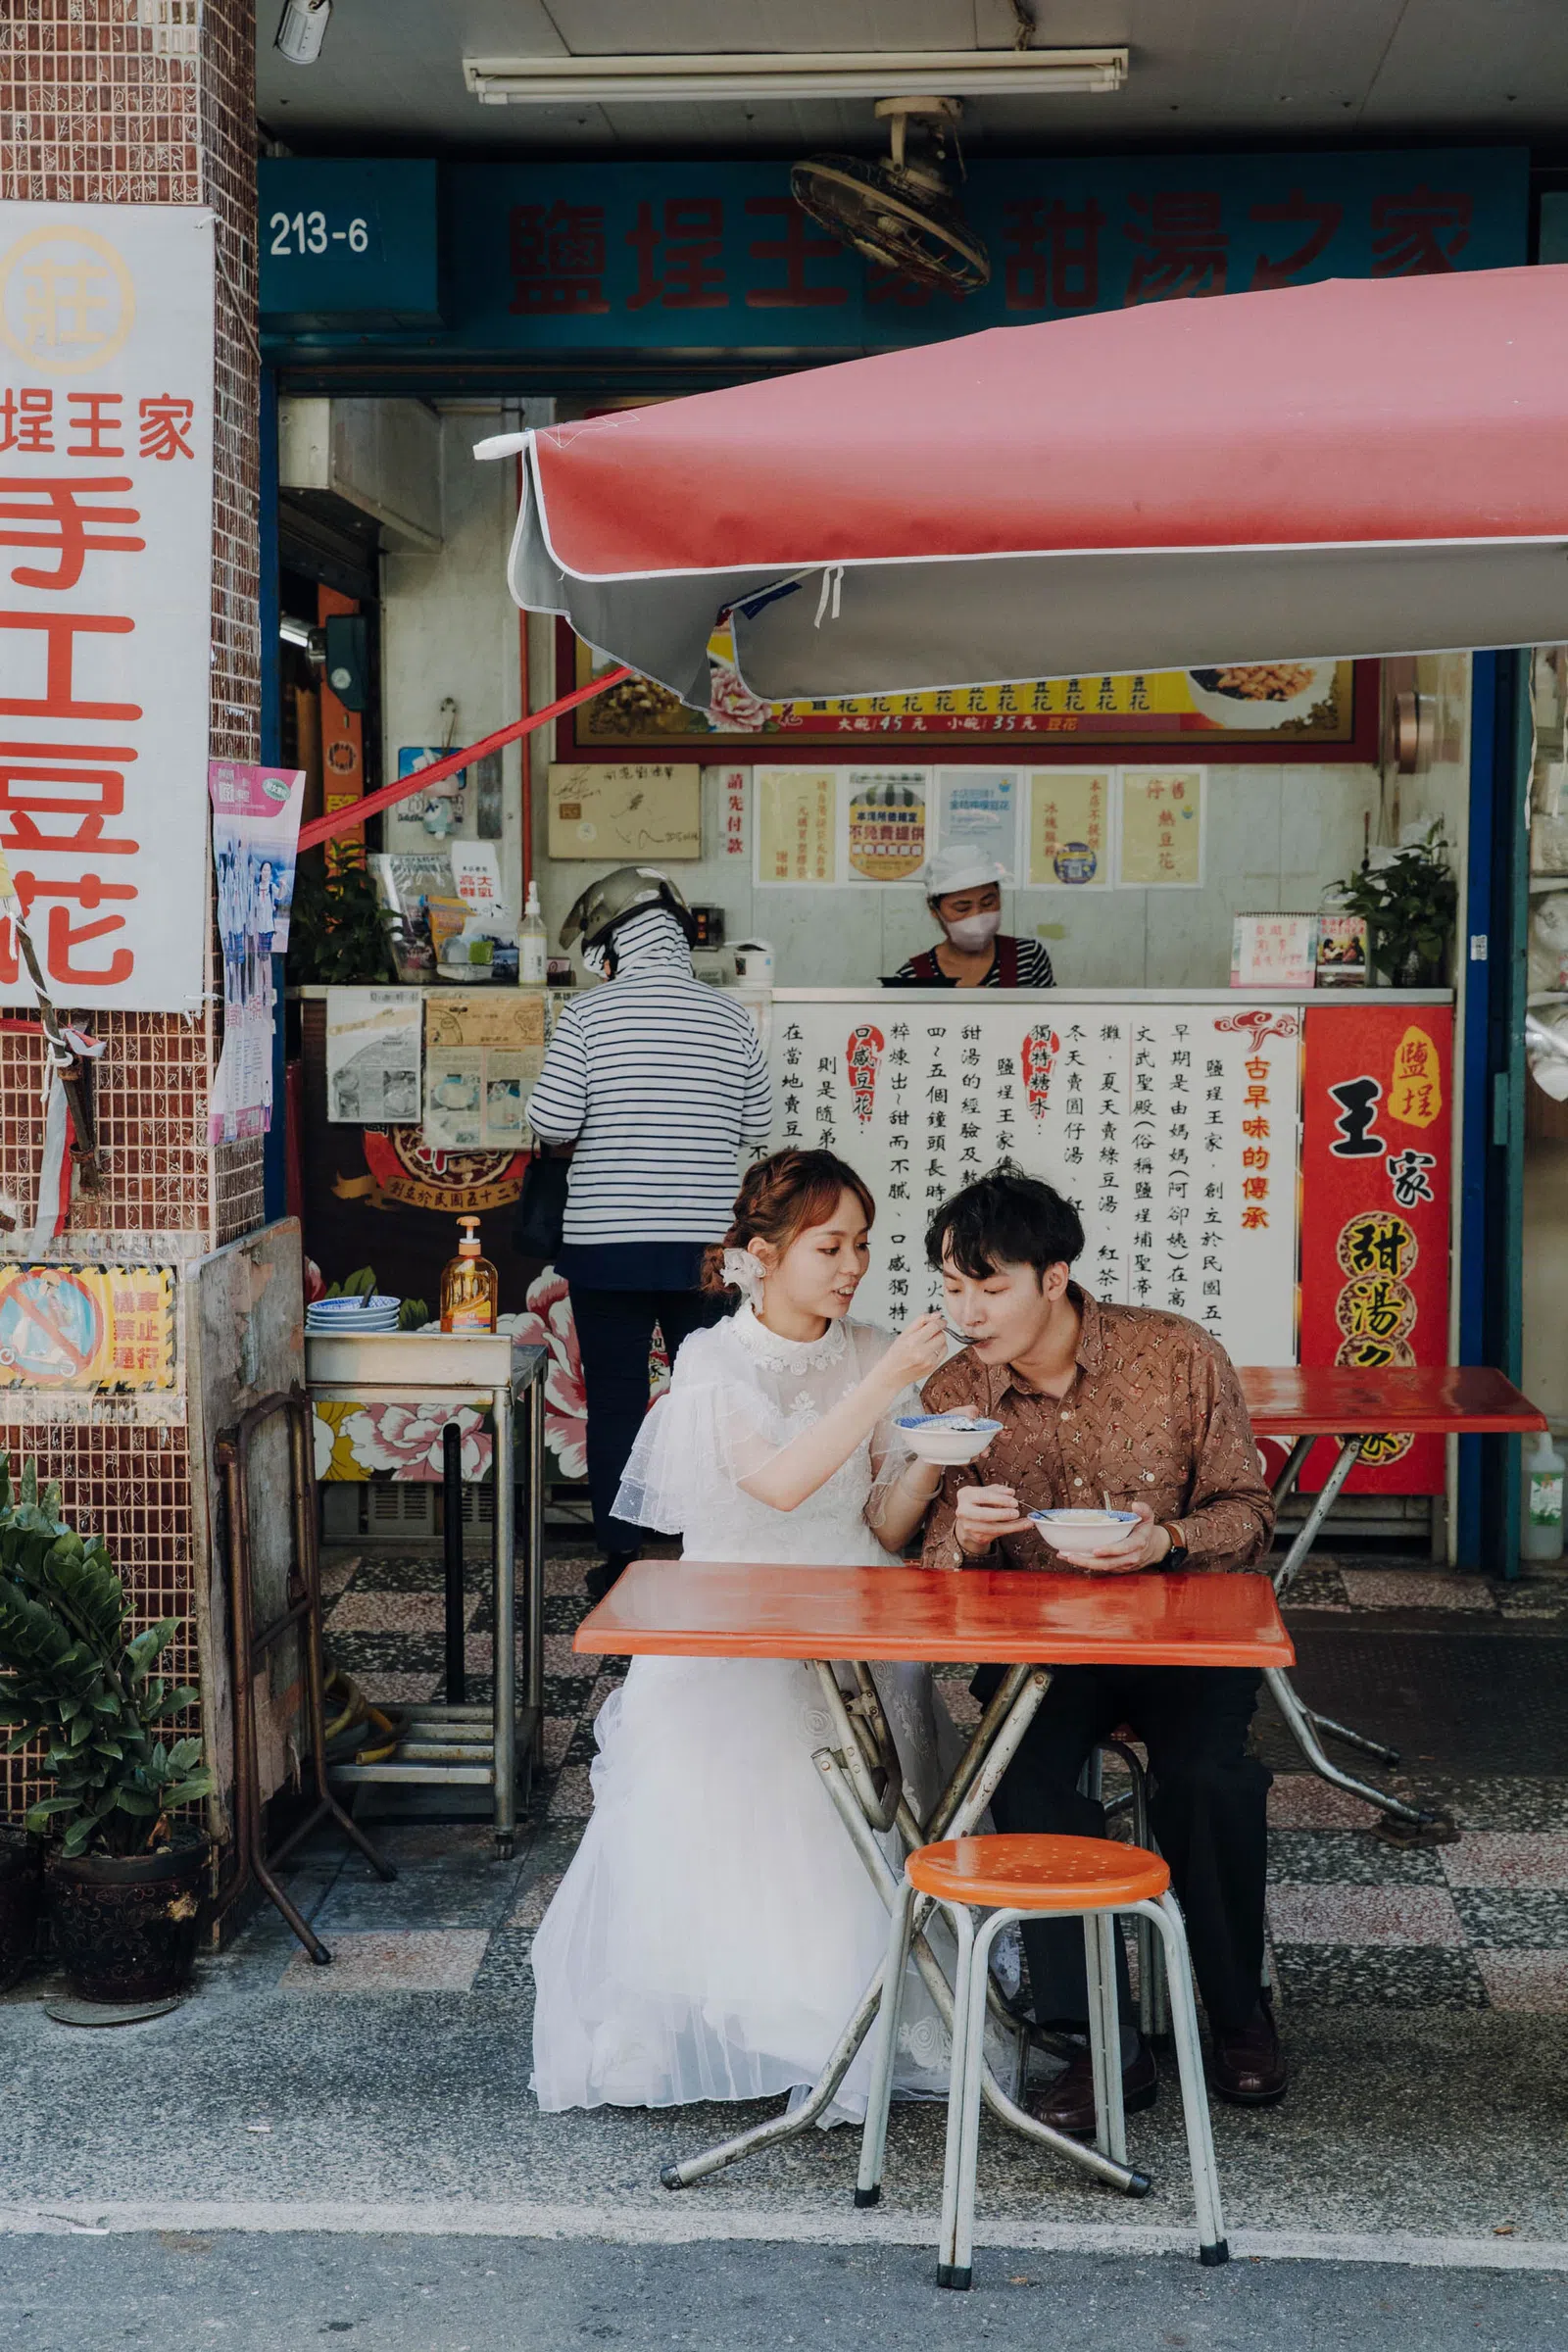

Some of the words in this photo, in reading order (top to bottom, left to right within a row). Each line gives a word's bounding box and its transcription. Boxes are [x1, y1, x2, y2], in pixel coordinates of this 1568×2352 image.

[270, 211, 368, 255] 213-6
[24, 259, 108, 346] 莊
[0, 476, 146, 985] 手工豆花
[727, 773, 744, 855] 請先付款
[1157, 808, 1175, 870] 熱豆花
[781, 1022, 804, 1152] 在當地賣豆
[1398, 1041, 1436, 1119] 鹽埕
[1241, 1055, 1272, 1230] 古早味的傳承
[1329, 1076, 1437, 1207] 王家
[113, 1291, 160, 1314] 機車
[113, 1318, 160, 1342] 禁止
[113, 1347, 160, 1370] 通行
